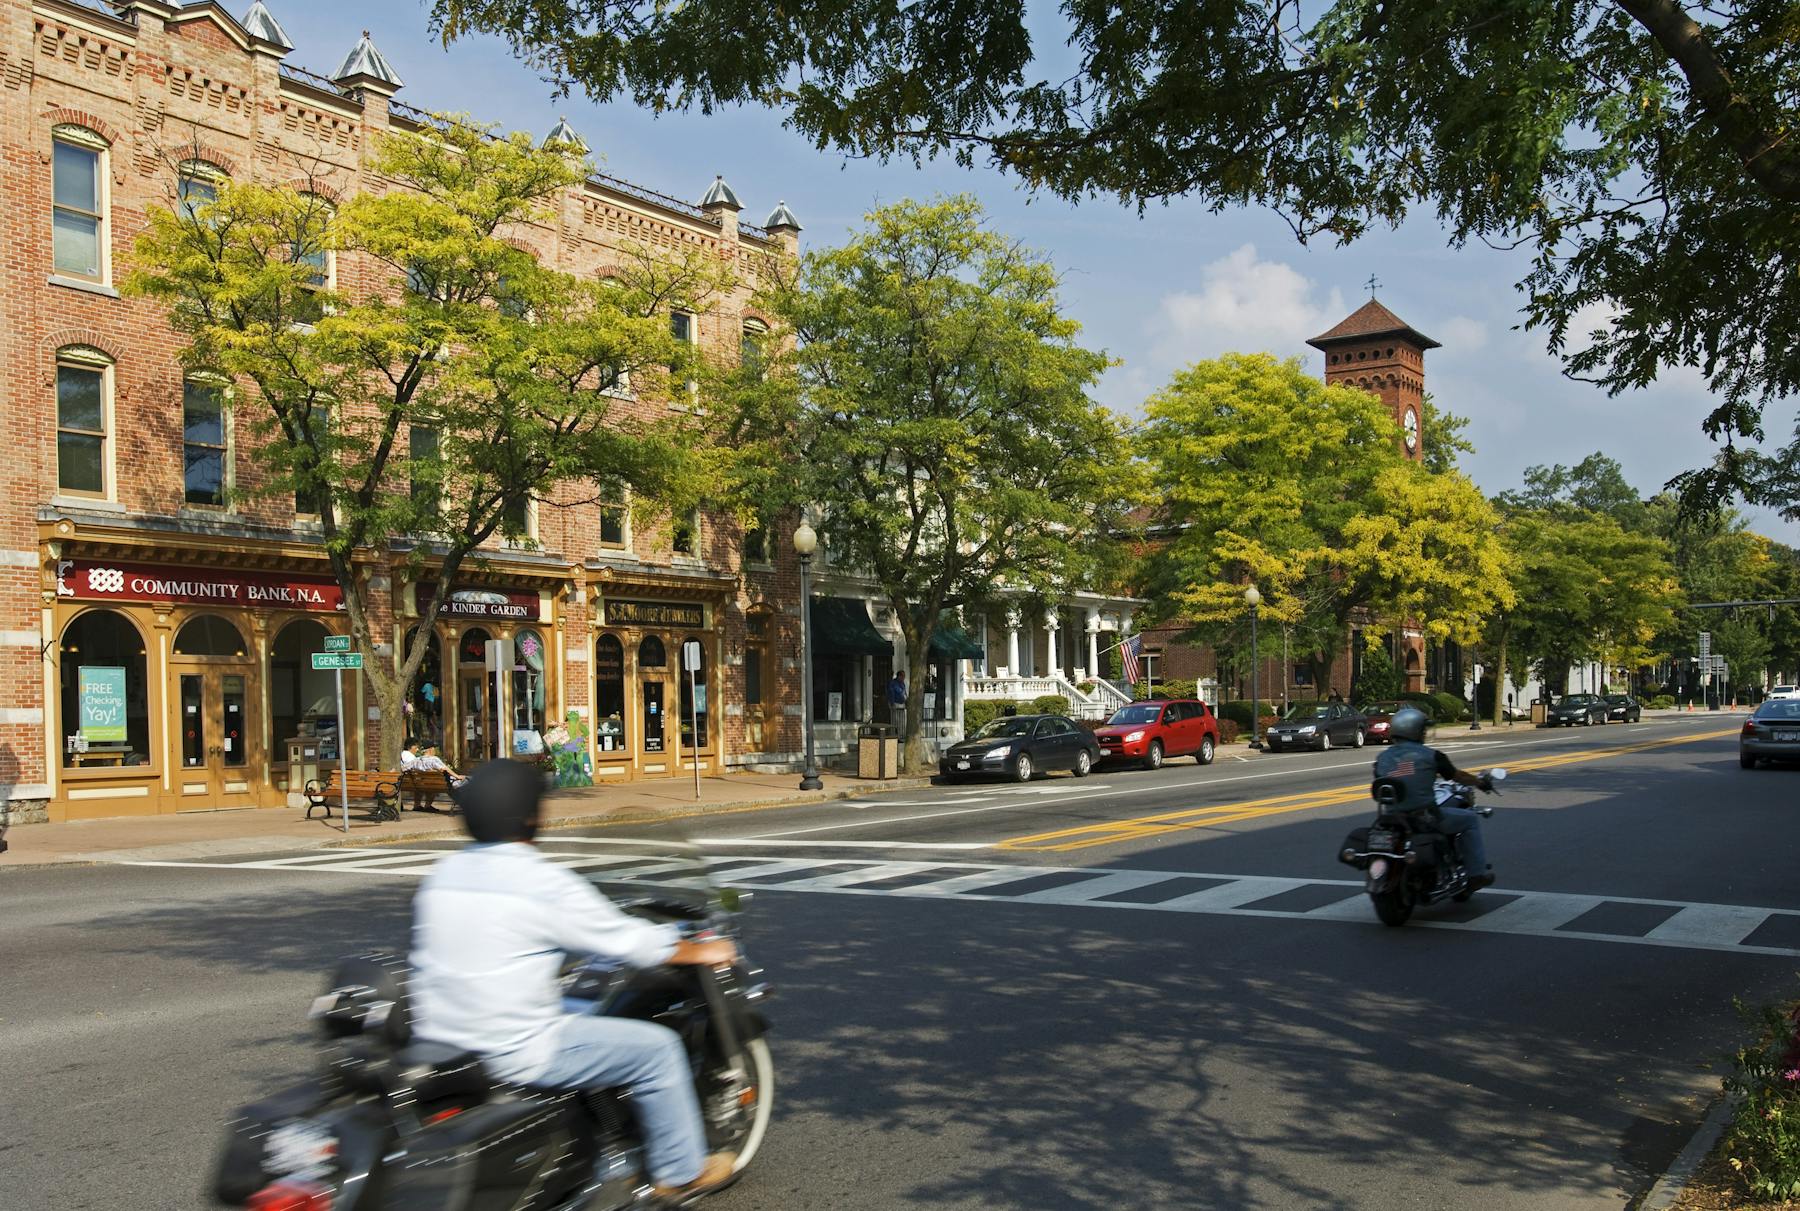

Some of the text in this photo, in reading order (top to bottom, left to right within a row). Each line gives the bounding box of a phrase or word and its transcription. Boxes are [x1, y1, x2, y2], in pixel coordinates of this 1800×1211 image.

[131, 578, 326, 603] COMMUNITY BANK, N.A.
[452, 602, 487, 614] KINDER
[490, 605, 528, 617] GARDEN
[318, 656, 355, 666] GENESEE
[85, 682, 113, 694] FREE
[86, 706, 117, 725] Yay!
